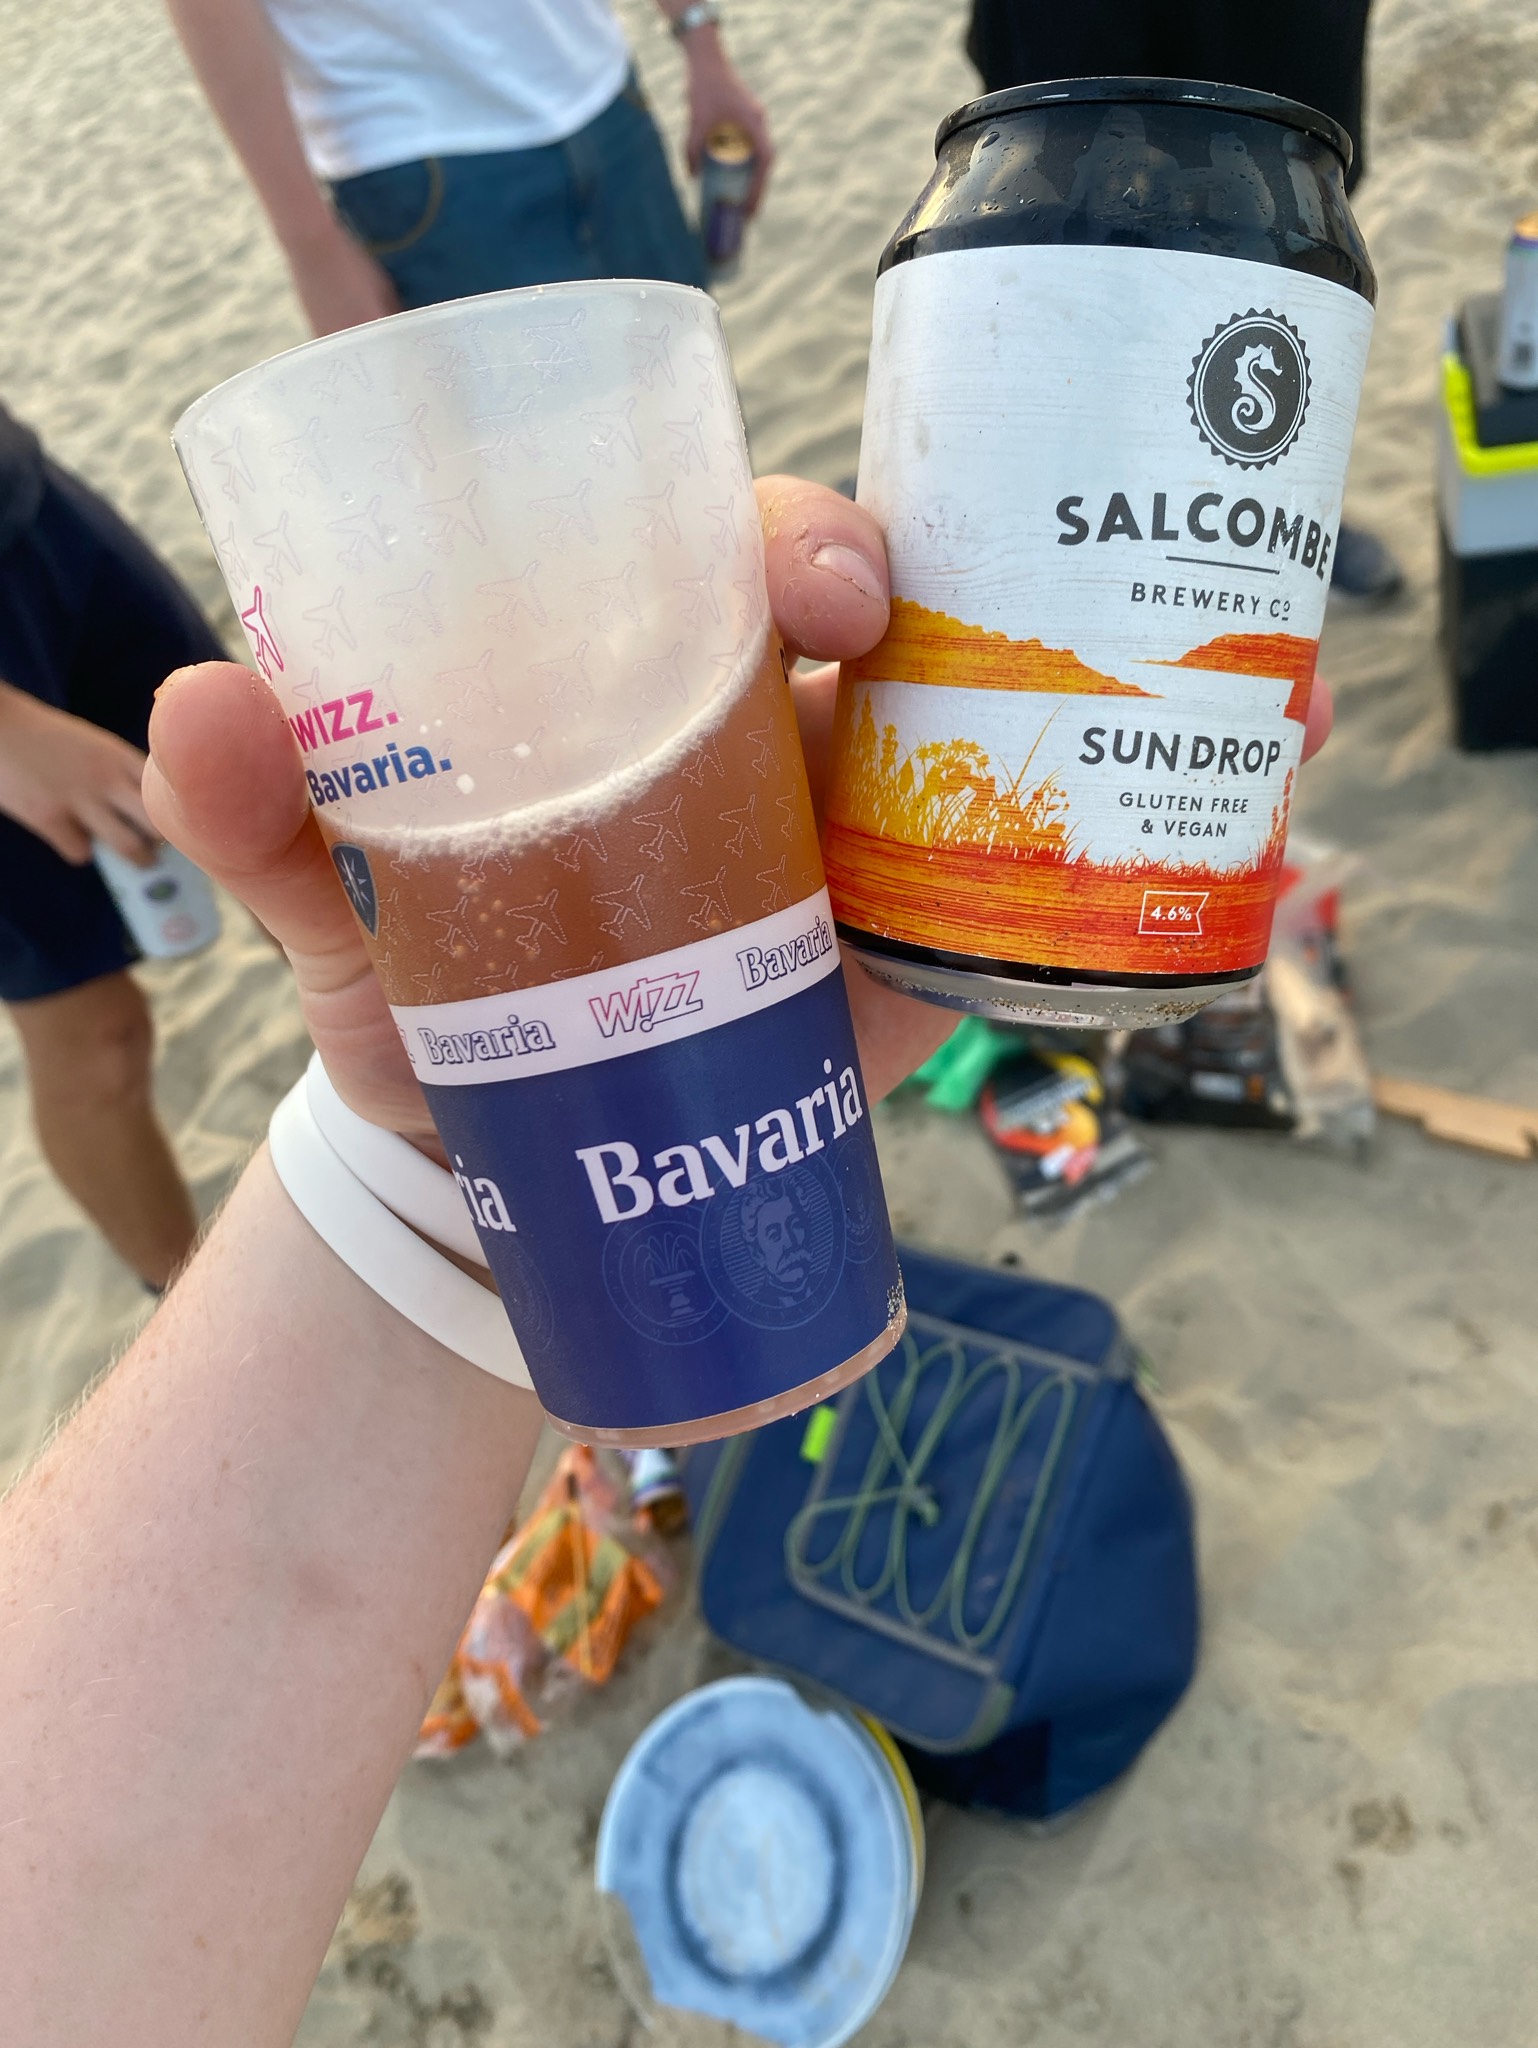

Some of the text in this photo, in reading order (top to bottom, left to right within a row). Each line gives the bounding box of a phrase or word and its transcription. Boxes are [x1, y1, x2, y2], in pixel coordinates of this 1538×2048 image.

[1055, 491, 1333, 581] SALCOMBE
[1130, 581, 1260, 616] BREWERY
[305, 742, 453, 807] Bavaria.
[1119, 791, 1249, 814] GLUTEN FREE
[1141, 818, 1228, 838] & VEGAN
[1150, 905, 1192, 922] 4.6%
[417, 1014, 556, 1066] Bavaria
[735, 915, 833, 992] Bavaria
[575, 1057, 863, 1225] Bavaria
